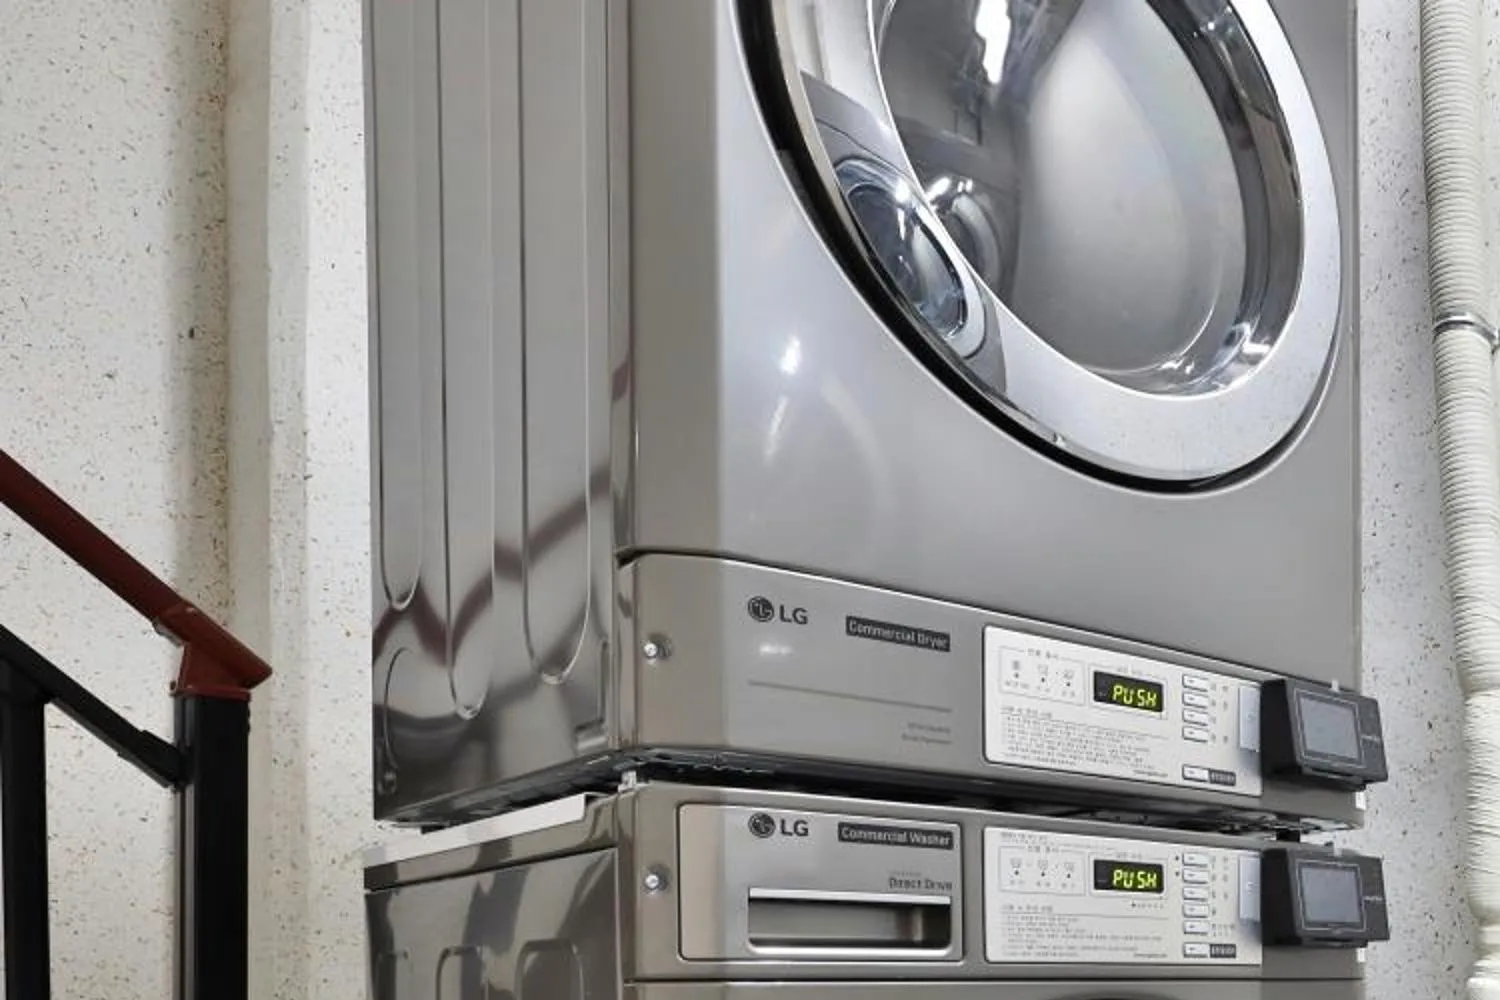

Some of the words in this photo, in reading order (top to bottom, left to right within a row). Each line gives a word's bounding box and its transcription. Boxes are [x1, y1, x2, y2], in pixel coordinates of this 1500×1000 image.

[779, 604, 809, 625] LG
[848, 619, 914, 643] Commercial
[917, 633, 948, 649] Dryer
[1112, 684, 1158, 707] PUSH
[780, 818, 809, 837] LG
[841, 826, 907, 843] Commercial
[909, 830, 951, 846] Washer
[889, 876, 921, 889] Direct
[1112, 869, 1158, 889] PUSH
